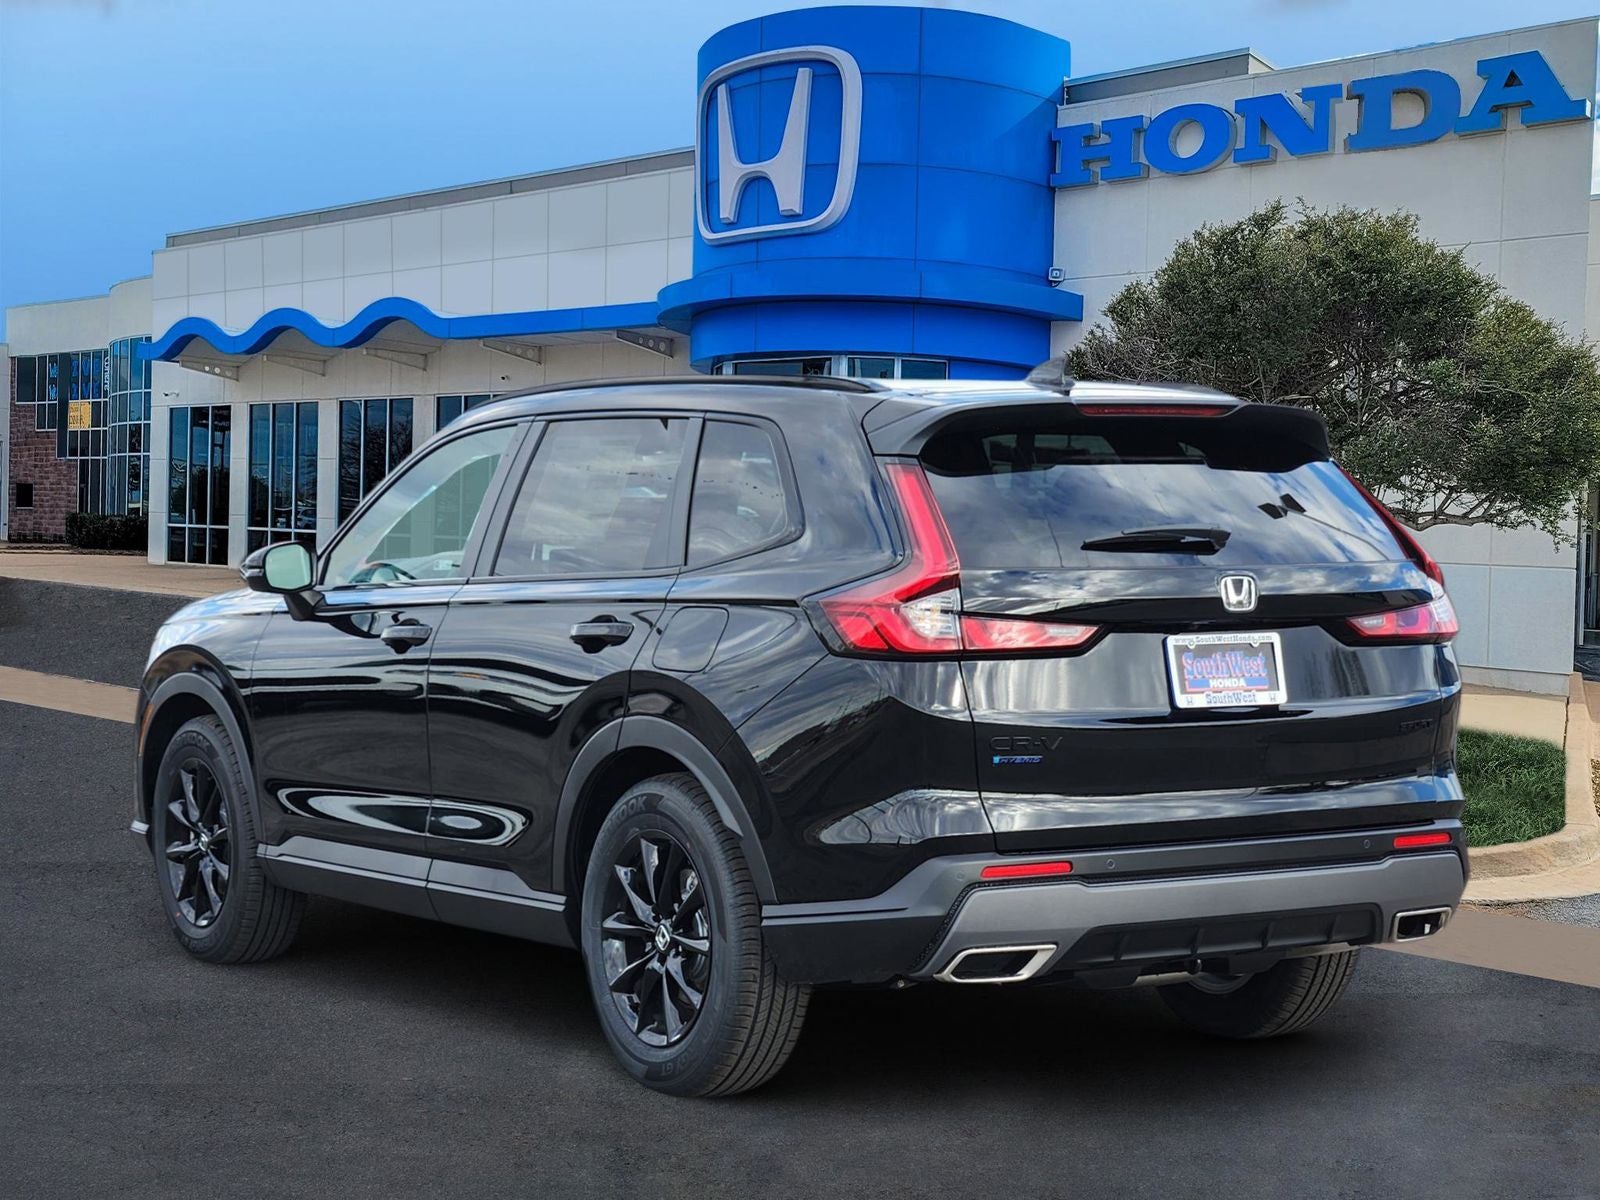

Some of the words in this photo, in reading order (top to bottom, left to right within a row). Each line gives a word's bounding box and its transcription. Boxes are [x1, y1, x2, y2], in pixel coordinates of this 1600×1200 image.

[1049, 49, 1591, 188] HONDA
[1175, 635, 1273, 643] www.SouthWestHonda.com
[1182, 650, 1268, 679] SouthWest
[1209, 678, 1247, 688] HONDA
[1205, 691, 1257, 705] SouthWest
[990, 736, 1064, 751] CR-V
